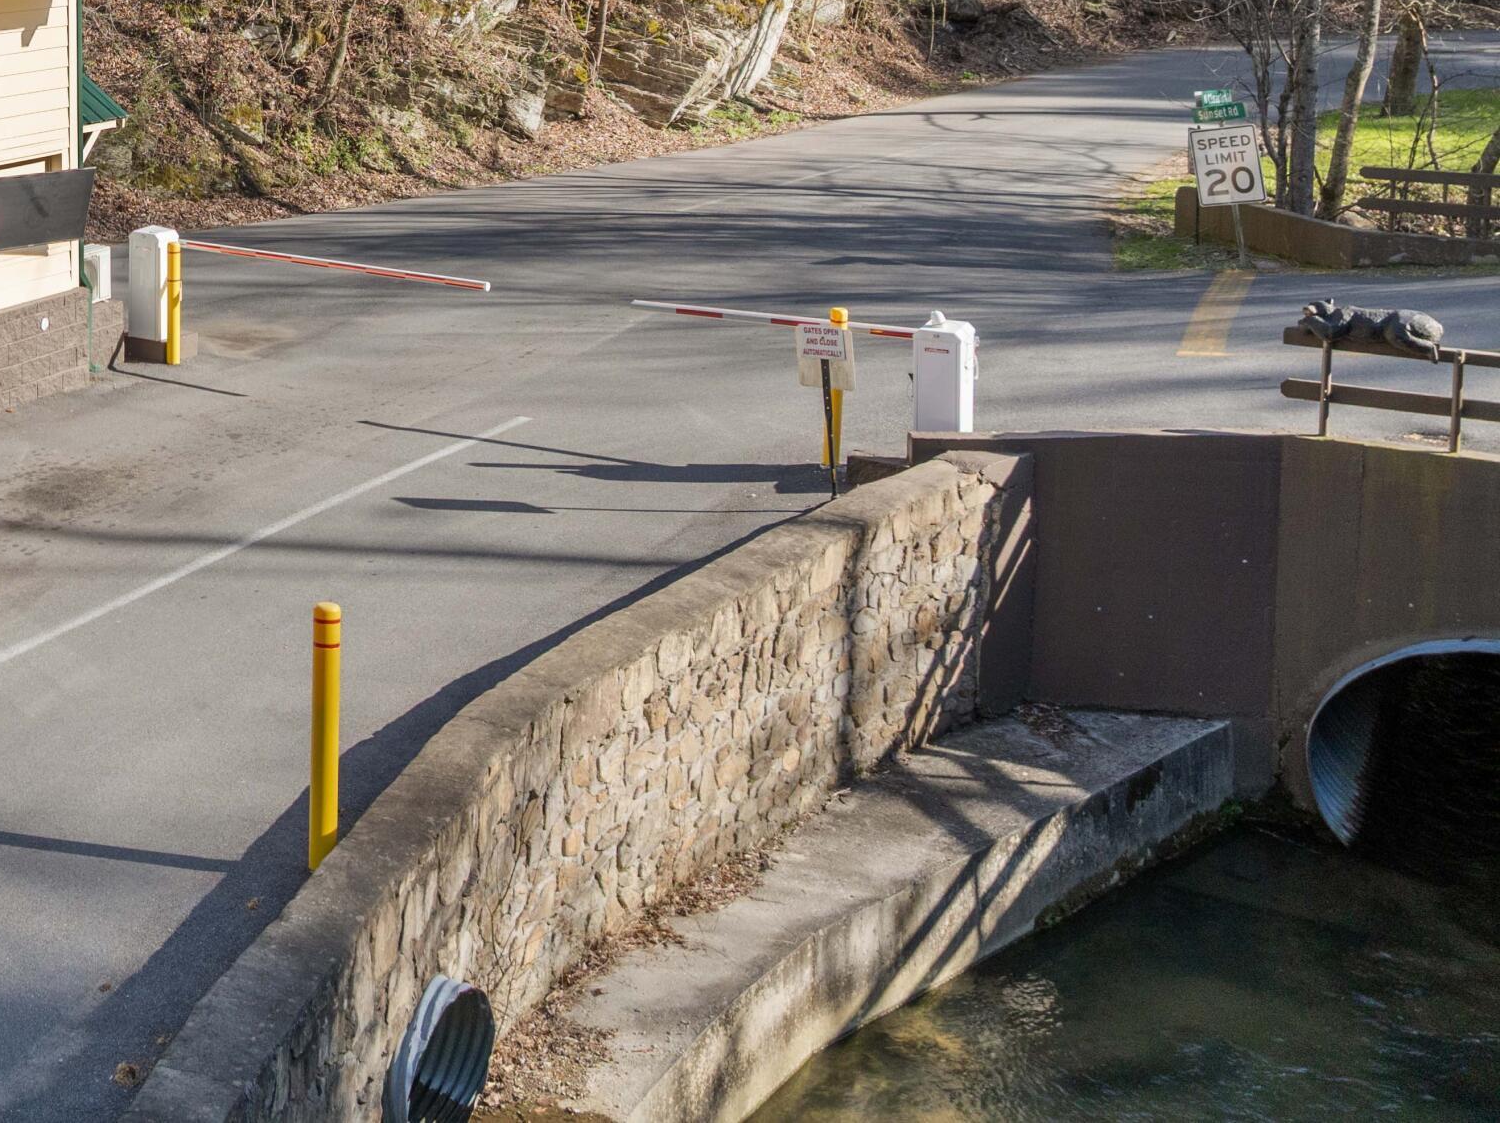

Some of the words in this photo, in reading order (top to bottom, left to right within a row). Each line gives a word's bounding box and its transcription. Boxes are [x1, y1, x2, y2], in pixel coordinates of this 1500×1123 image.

[1198, 108, 1227, 121] Sunset
[1228, 105, 1239, 117] Rd
[1197, 135, 1251, 150] SPEED
[1205, 151, 1247, 165] LIMIT
[1204, 166, 1255, 197] 20
[803, 327, 822, 335] GATES
[823, 328, 839, 336] OPEN
[820, 338, 838, 346] CLOSE
[803, 348, 842, 357] AUTOMATICALLY
